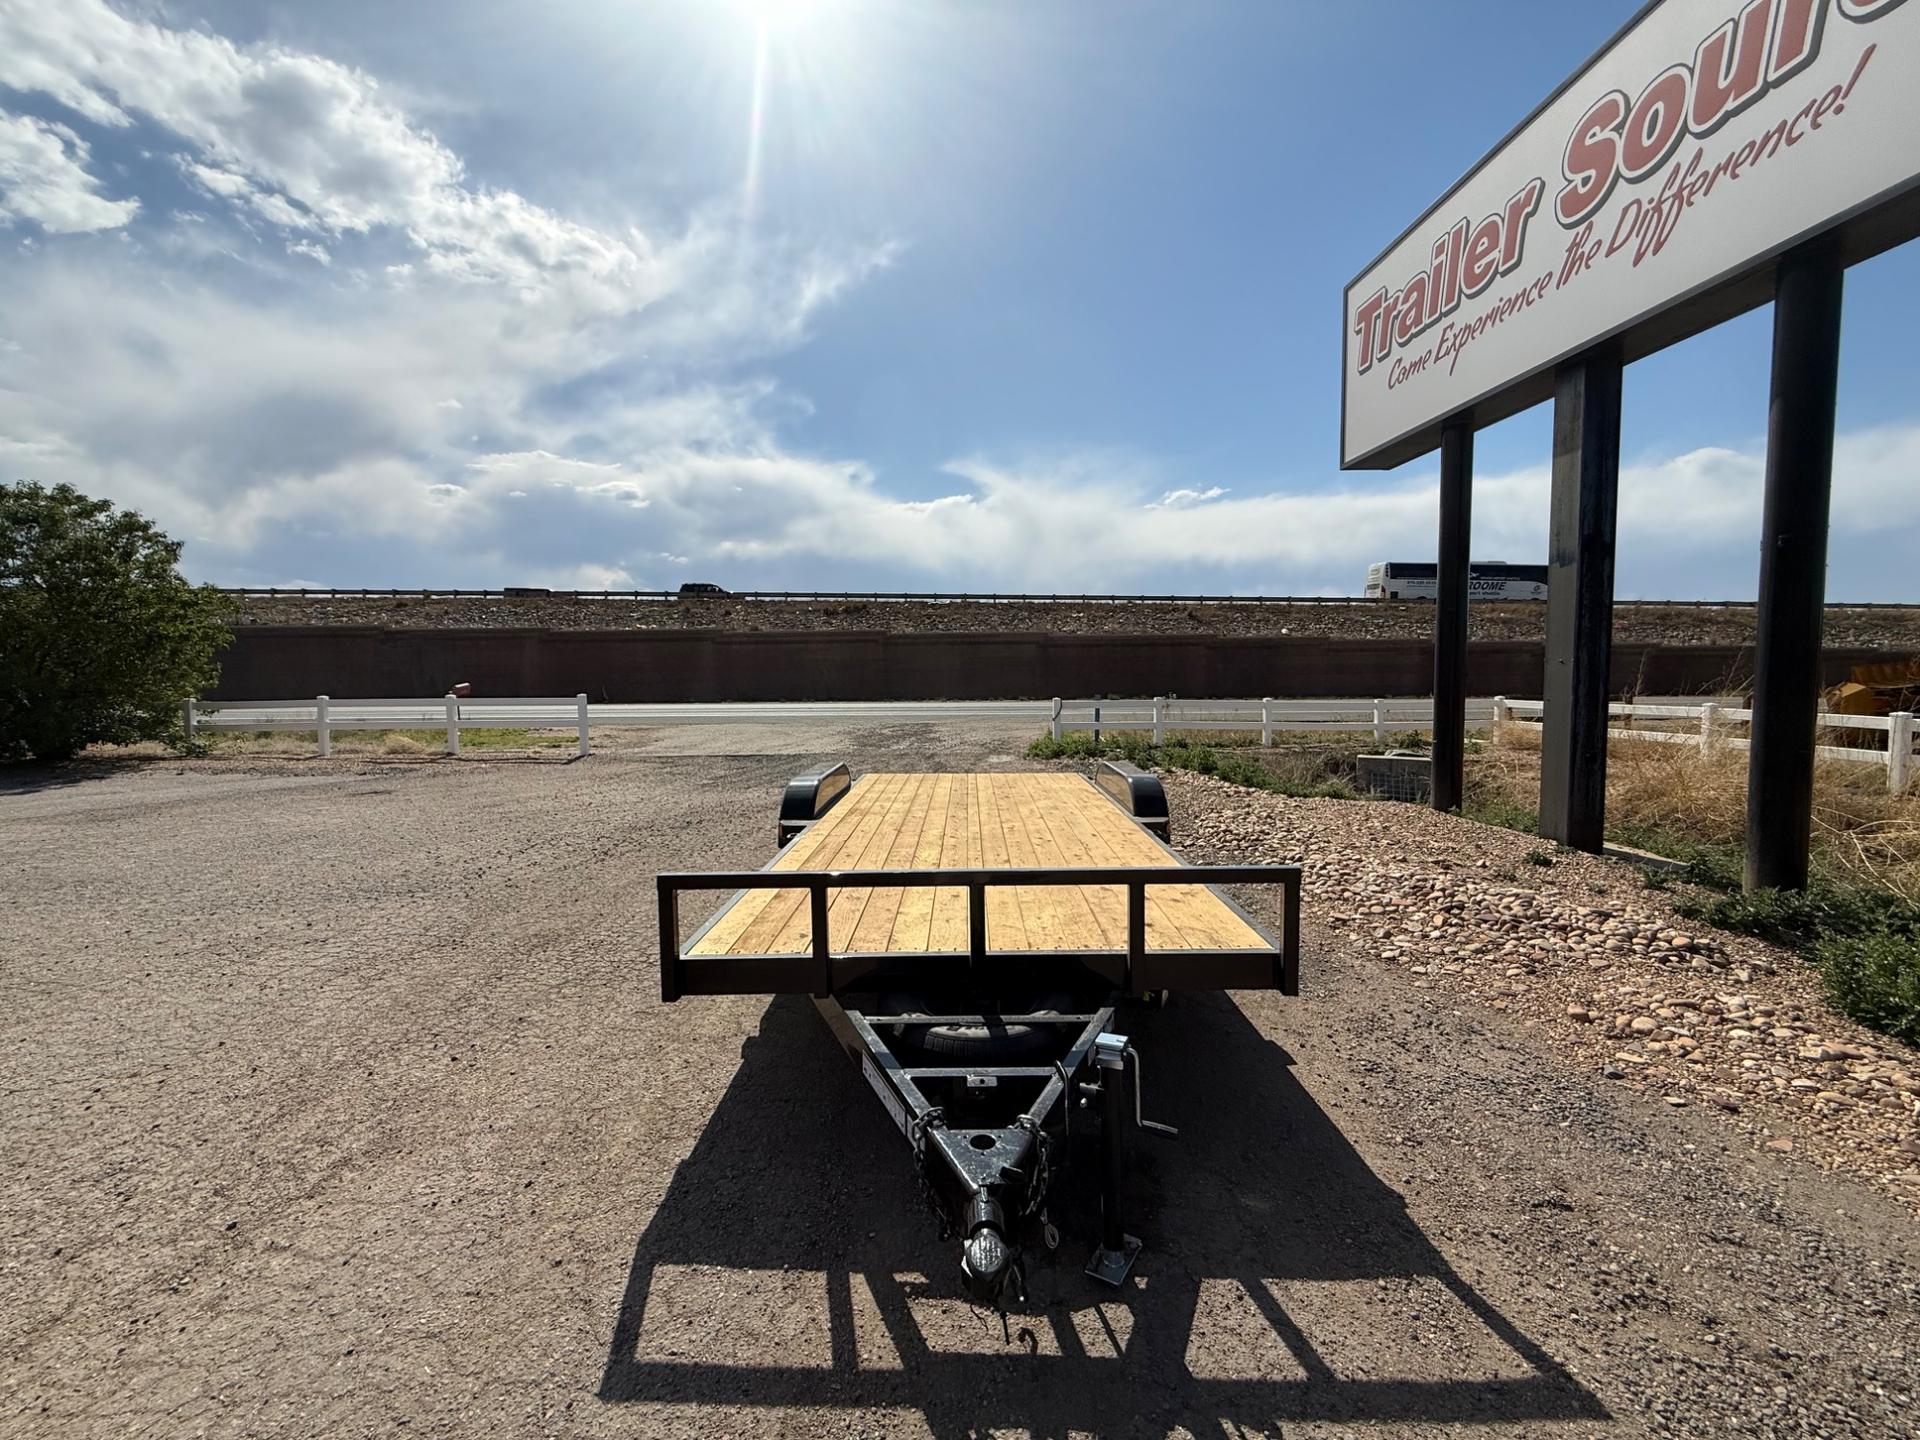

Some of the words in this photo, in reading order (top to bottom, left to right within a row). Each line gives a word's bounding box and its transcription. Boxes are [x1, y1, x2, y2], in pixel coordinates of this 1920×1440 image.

[1354, 177, 1546, 376] Trailer
[1555, 0, 1905, 230] Sour
[1387, 348, 1432, 390] Come
[1433, 270, 1554, 377] Experience
[1604, 43, 1878, 268] Difference!
